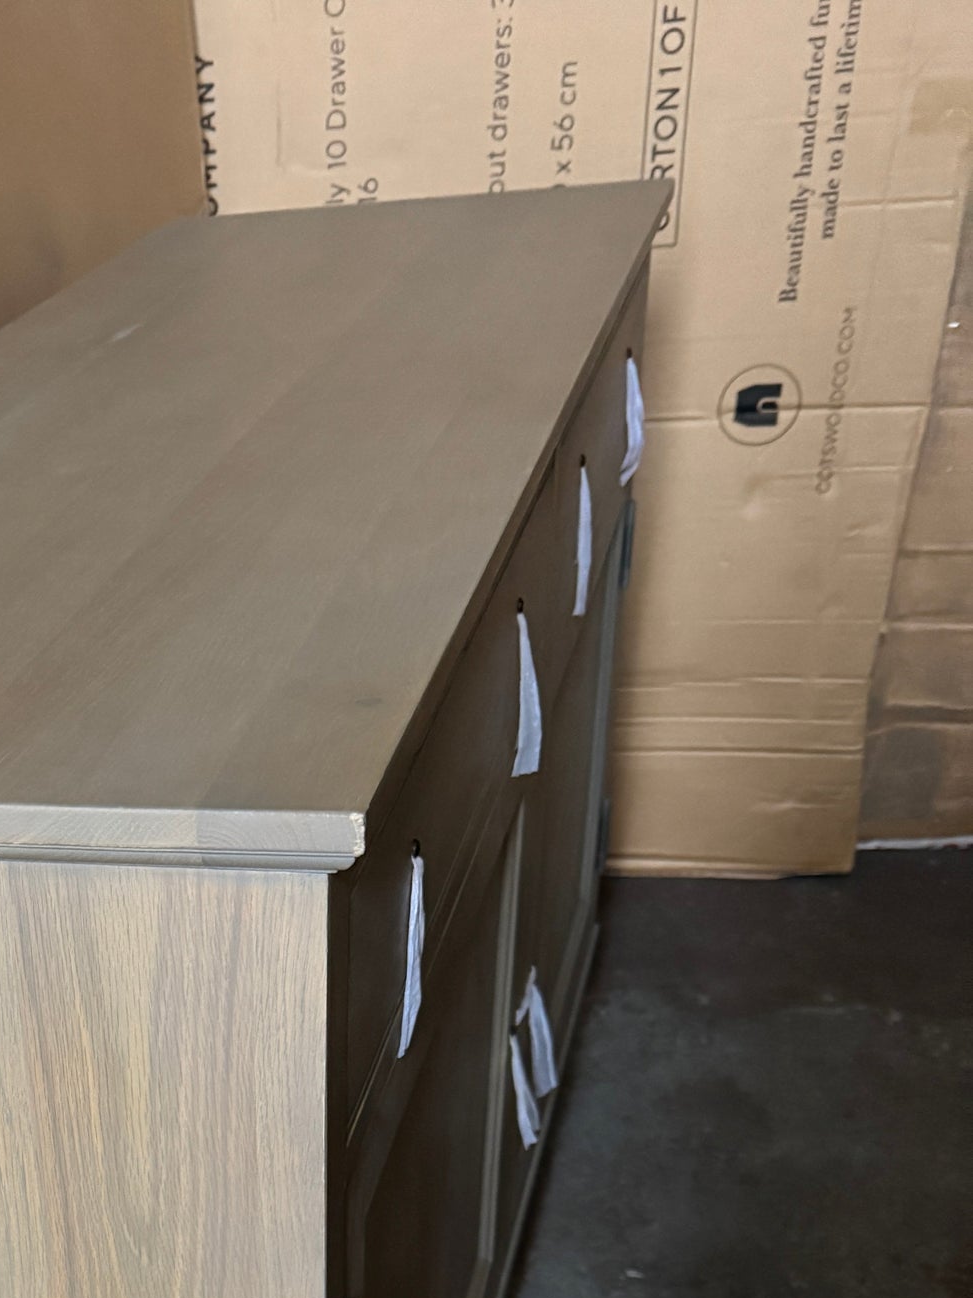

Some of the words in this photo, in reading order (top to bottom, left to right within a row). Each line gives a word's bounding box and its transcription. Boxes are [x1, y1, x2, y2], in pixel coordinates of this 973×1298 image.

[660, 5, 687, 55] OF
[325, 27, 347, 131] Drawer
[560, 61, 578, 105] cm
[838, 81, 852, 95] a
[793, 35, 827, 178] handcrafted
[826, 102, 850, 144] last
[325, 140, 347, 169] 10
[550, 115, 576, 152] 56
[828, 148, 844, 173] to
[822, 178, 840, 239] made
[778, 185, 816, 303] Beautifully
